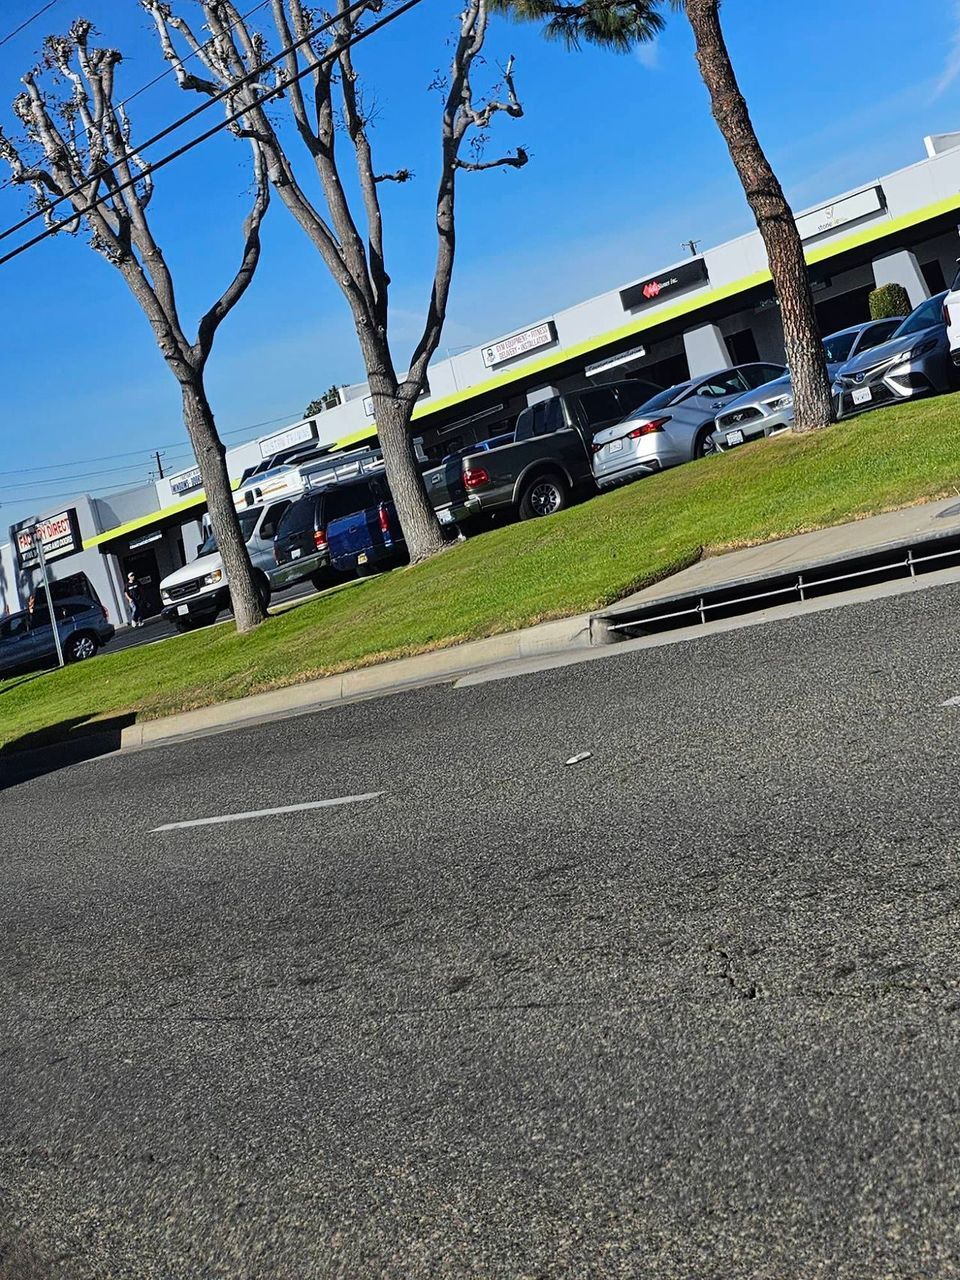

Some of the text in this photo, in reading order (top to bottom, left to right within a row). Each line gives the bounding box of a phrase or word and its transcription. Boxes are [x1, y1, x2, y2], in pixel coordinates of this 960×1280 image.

[496, 325, 548, 353] GYM EQUIPMENT FITNESS
[499, 334, 548, 360] DELIVERY INSTALLATION
[19, 526, 47, 548] FACRY
[46, 518, 70, 538] DIRECT
